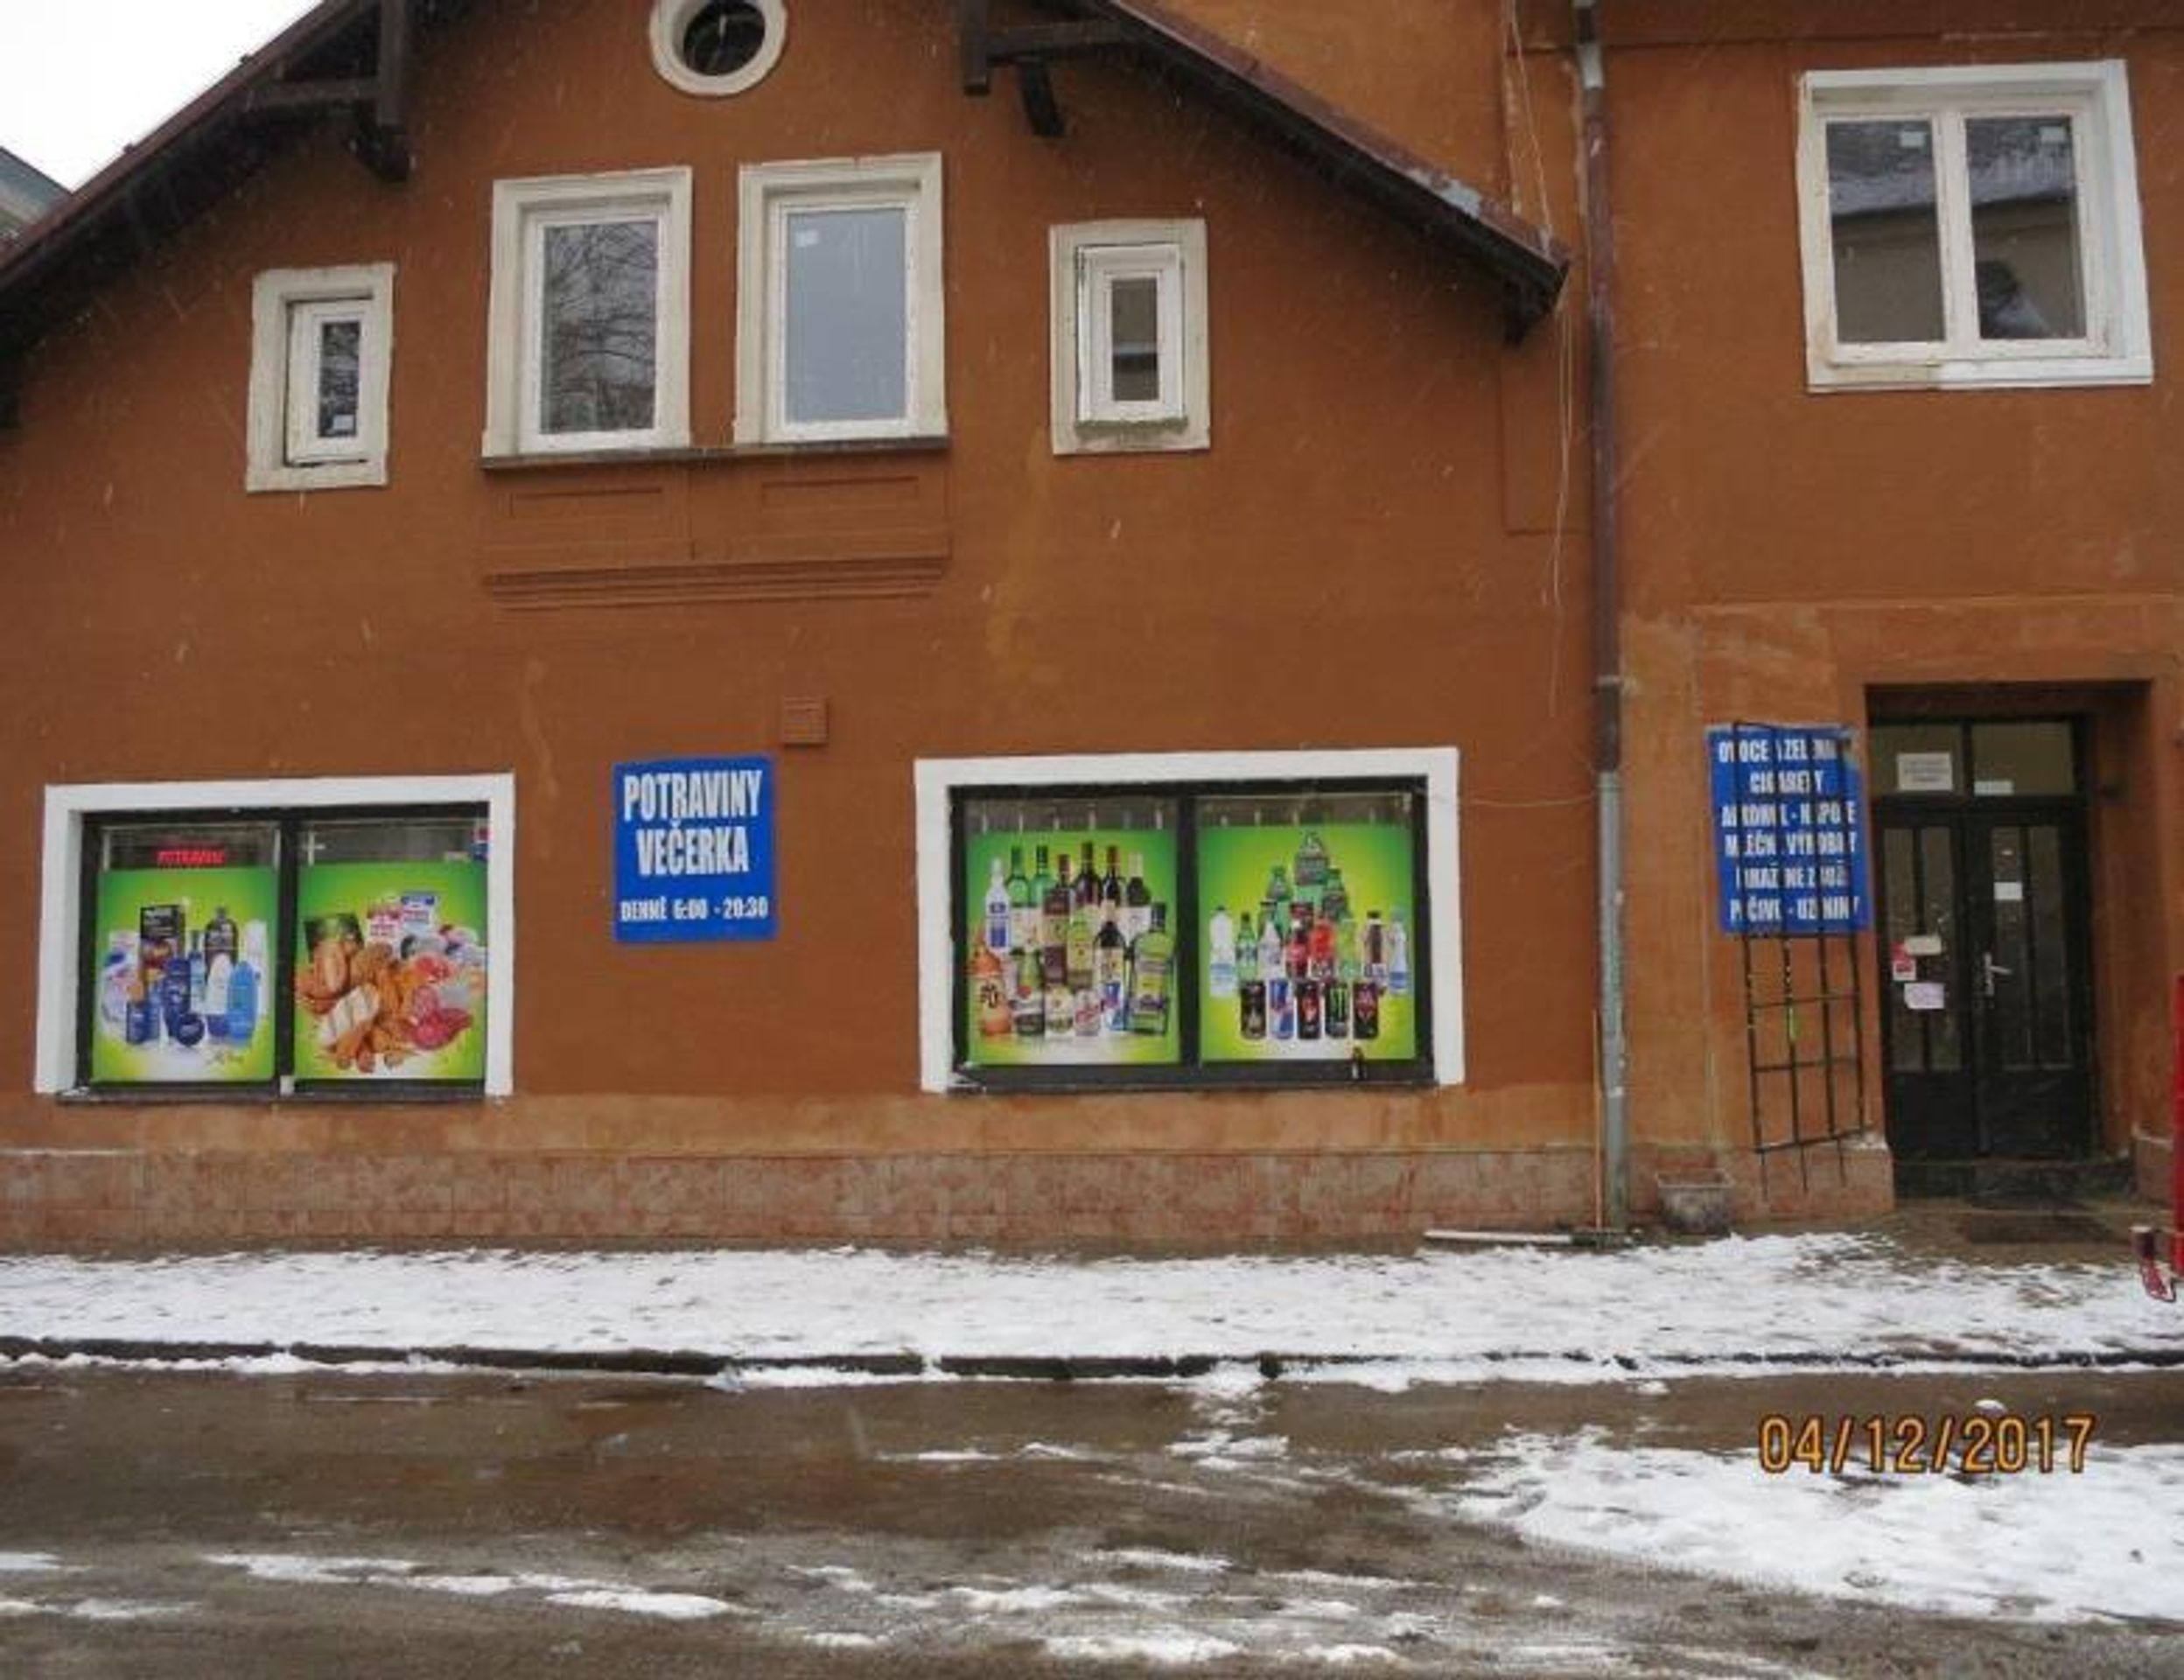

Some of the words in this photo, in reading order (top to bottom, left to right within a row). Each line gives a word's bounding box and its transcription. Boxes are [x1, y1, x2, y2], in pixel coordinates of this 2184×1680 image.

[624, 770, 763, 822] POTRAVINY
[635, 820, 750, 876] VEČERKA
[672, 898, 709, 920] 6:00
[722, 895, 769, 920] 20:30
